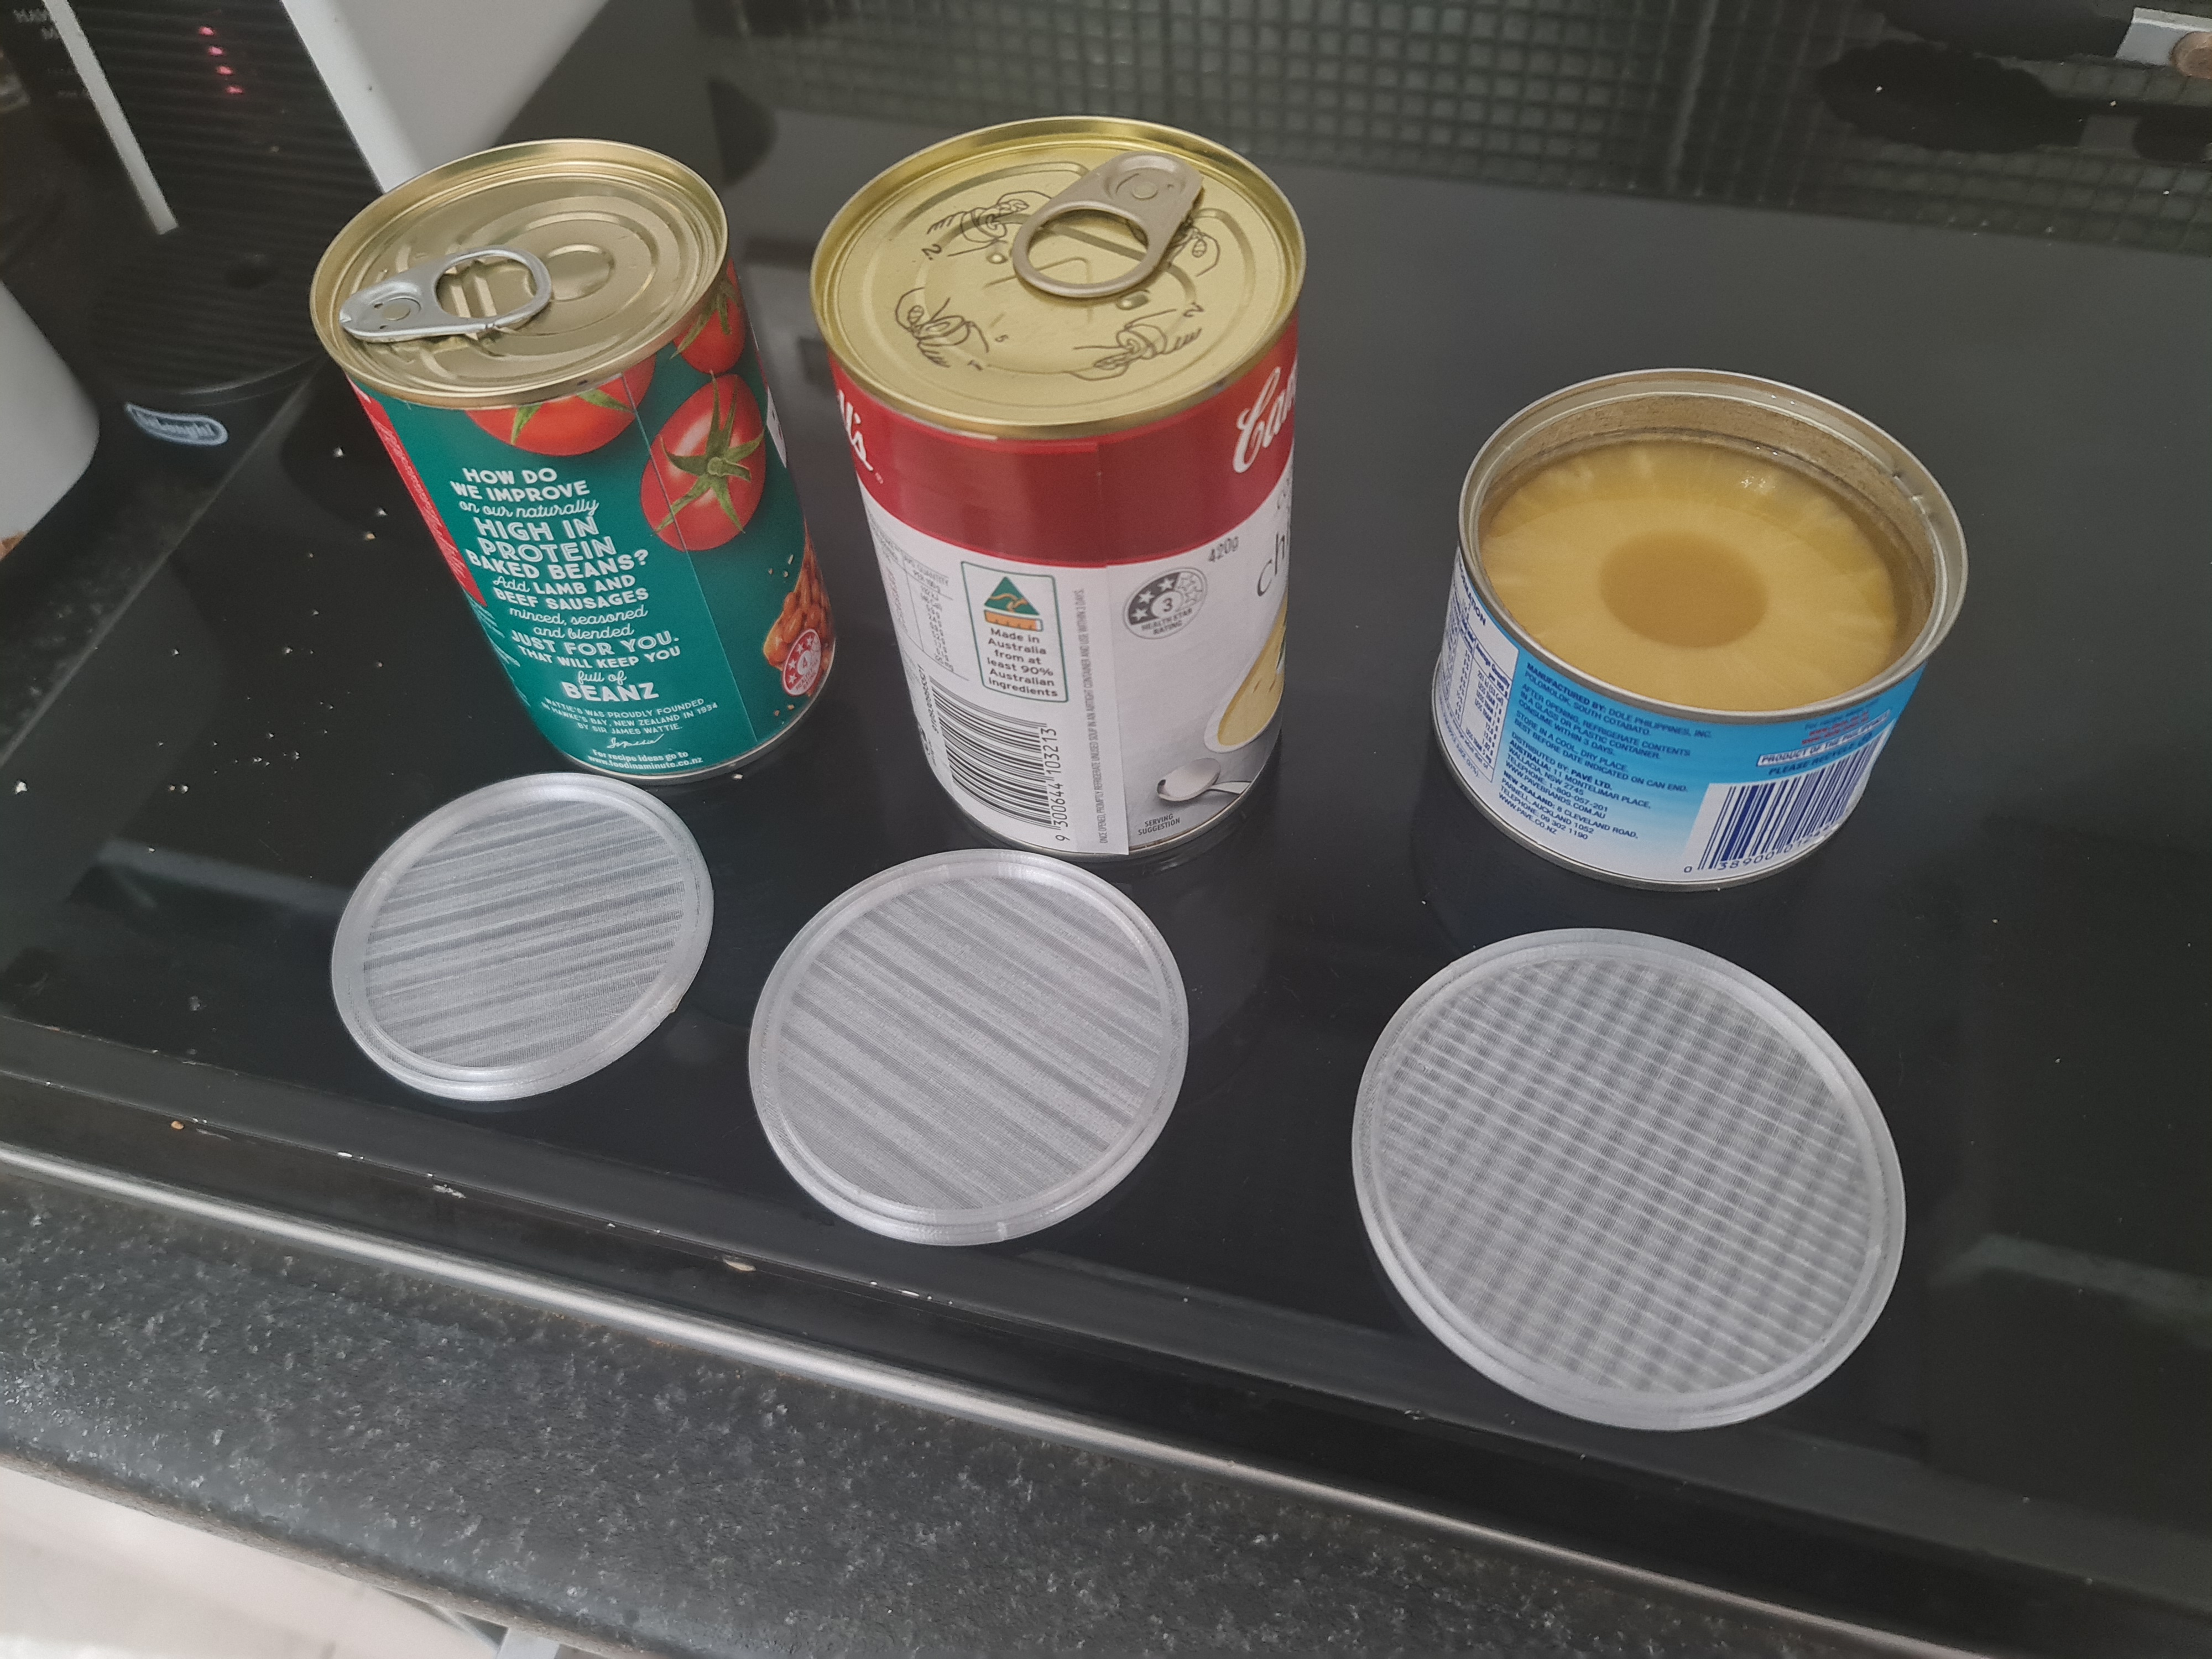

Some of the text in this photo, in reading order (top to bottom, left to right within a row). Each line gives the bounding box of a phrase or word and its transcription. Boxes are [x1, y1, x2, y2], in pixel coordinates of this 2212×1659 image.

[462, 468, 557, 484] HOW DO
[450, 480, 590, 502] WE IMPROVE
[459, 499, 599, 518] on our naturally
[473, 516, 599, 541] HIGH IN
[477, 536, 617, 562] PROTEIN
[465, 549, 649, 580] BAKED BEANS?
[493, 575, 635, 595] Add LAMB AND
[493, 587, 649, 610] BEEF SAUSAGES
[1162, 598, 1173, 612] 3
[509, 604, 648, 626] minced, seasoned
[533, 623, 635, 639] and blended
[990, 628, 1040, 643] Made in
[512, 629, 680, 656] JUST FOR YOU.
[988, 638, 1046, 654] Australia
[517, 644, 681, 668] THAT WILL KEEP YOU
[995, 649, 1024, 662] from
[987, 657, 1053, 676] least 90%
[577, 670, 627, 685] full of
[989, 677, 1057, 696] ingredients
[990, 669, 1054, 686] Australian
[561, 681, 659, 702] BEANZ
[1527, 662, 1590, 705] MANUFACTURED
[1609, 708, 1632, 721] DOLE
[585, 709, 604, 717] WAS
[608, 709, 653, 719] PROUDLY
[656, 698, 704, 715] FOUNDED
[638, 714, 681, 726] ZEALAND
[697, 702, 718, 714] 1934
[1520, 691, 1527, 701] IN
[1535, 702, 1559, 721] GLASS
[1560, 718, 1572, 728] OR
[1573, 724, 1608, 744] PLASTIC
[1574, 701, 1601, 719] SOUTH
[611, 727, 641, 735] JAMES
[644, 723, 683, 734] WATTIE.
[1519, 699, 1553, 727] CONSUME
[1554, 723, 1582, 742] WITHIN
[1583, 737, 1589, 745] 3
[1522, 684, 1544, 703] AFTER
[1583, 720, 1640, 745] REFRIGERATE
[1642, 740, 1691, 757] CONTENTS
[1088, 728, 1099, 740] SOUP
[1516, 710, 1538, 730] STORE
[1539, 727, 1547, 735] IN
[1580, 750, 1598, 761] DRY
[592, 749, 607, 758] For
[608, 752, 636, 763] recipe
[665, 753, 677, 761] go
[1041, 728, 1061, 775] 103213
[1512, 732, 1556, 765] DISTRIBUTED
[1595, 779, 1613, 790] LTD.
[1514, 718, 1531, 734] BEST
[1532, 732, 1561, 754] BEFORE
[1562, 750, 1583, 764] DATE
[1584, 760, 1629, 780] INDICATED
[1631, 776, 1645, 785] ON
[1646, 780, 1666, 789] CAN
[1761, 749, 1806, 763] PRODUCT
[587, 755, 703, 770] www.foodinaminute.co.nz
[1510, 740, 1551, 772] AUSTRALIA:
[1565, 775, 1620, 800] MONTELIMAR
[1769, 763, 1808, 775] PLEASE
[1545, 773, 1562, 785] NSW
[1564, 782, 1584, 795] 2745
[1048, 783, 1068, 827] 300644
[1503, 770, 1518, 785] NEW
[1520, 784, 1555, 808] ZEALAND:
[1564, 809, 1610, 831] CLEVELAND
[1549, 783, 1608, 812] 1-800-057-201
[1145, 813, 1173, 827] SERVING
[1499, 792, 1557, 836] WWW.PAVE.CO.NZ
[1532, 802, 1572, 825] AUCKLAND
[1574, 822, 1594, 834] 1052
[1138, 817, 1180, 836] SUGGESTION
[1540, 813, 1550, 822] 09
[1552, 820, 1567, 831] 302
[1568, 828, 1588, 840] 1190
[1098, 832, 1108, 843] ONCE
[1717, 851, 1775, 870] 38900
